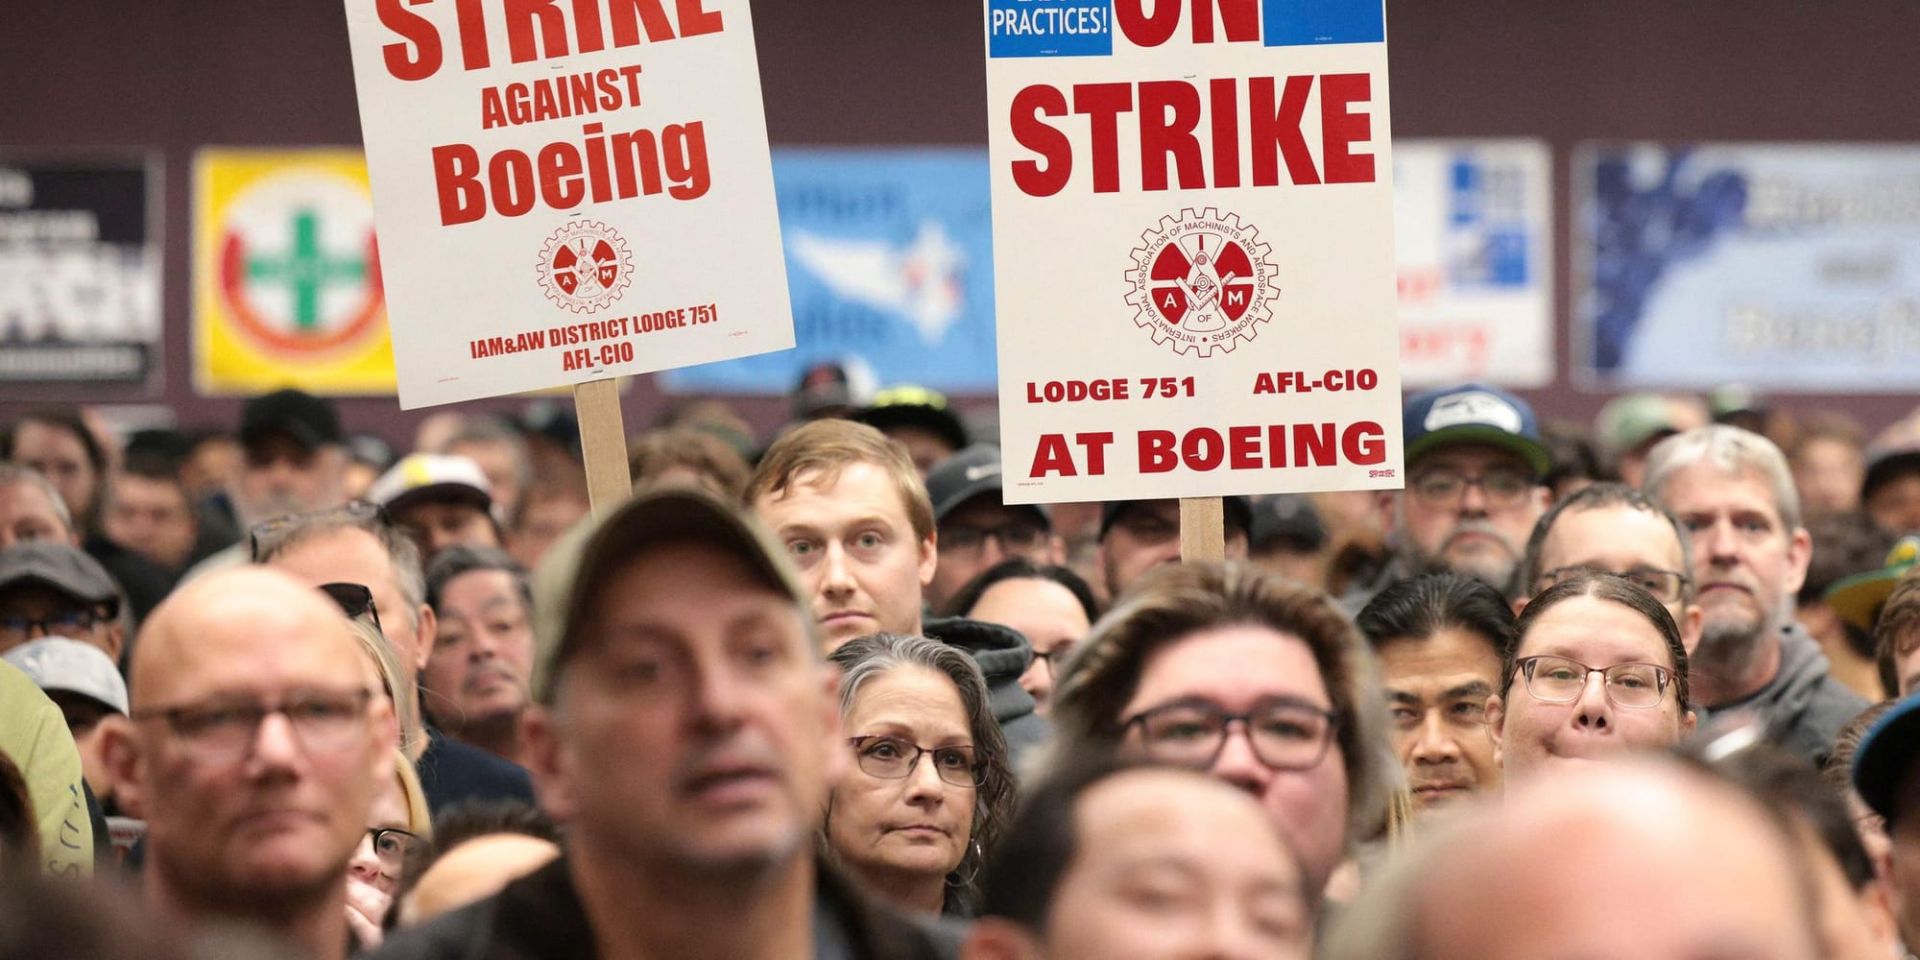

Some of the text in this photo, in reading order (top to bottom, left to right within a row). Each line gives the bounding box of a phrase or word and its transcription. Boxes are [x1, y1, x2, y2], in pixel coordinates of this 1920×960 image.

[993, 6, 1107, 36] PRACTICES!
[481, 65, 642, 130] AGAINST
[1010, 73, 1377, 197] STRIKE
[432, 121, 712, 226] Boeing
[562, 269, 613, 286] A M
[1138, 221, 1266, 343] INTERNATIONAL ASSOCIATION OF MACHINISTS AND AEROSPACE WORKERS
[1163, 291, 1243, 308] A M
[470, 303, 717, 359] IAM&AW DISTRICT LODGE 751
[1197, 314, 1212, 323] OF
[563, 341, 634, 371] AFL-CIO
[1026, 368, 1378, 403] LODGE 751 AFL-CIO
[1029, 421, 1387, 478] AT BOEING
